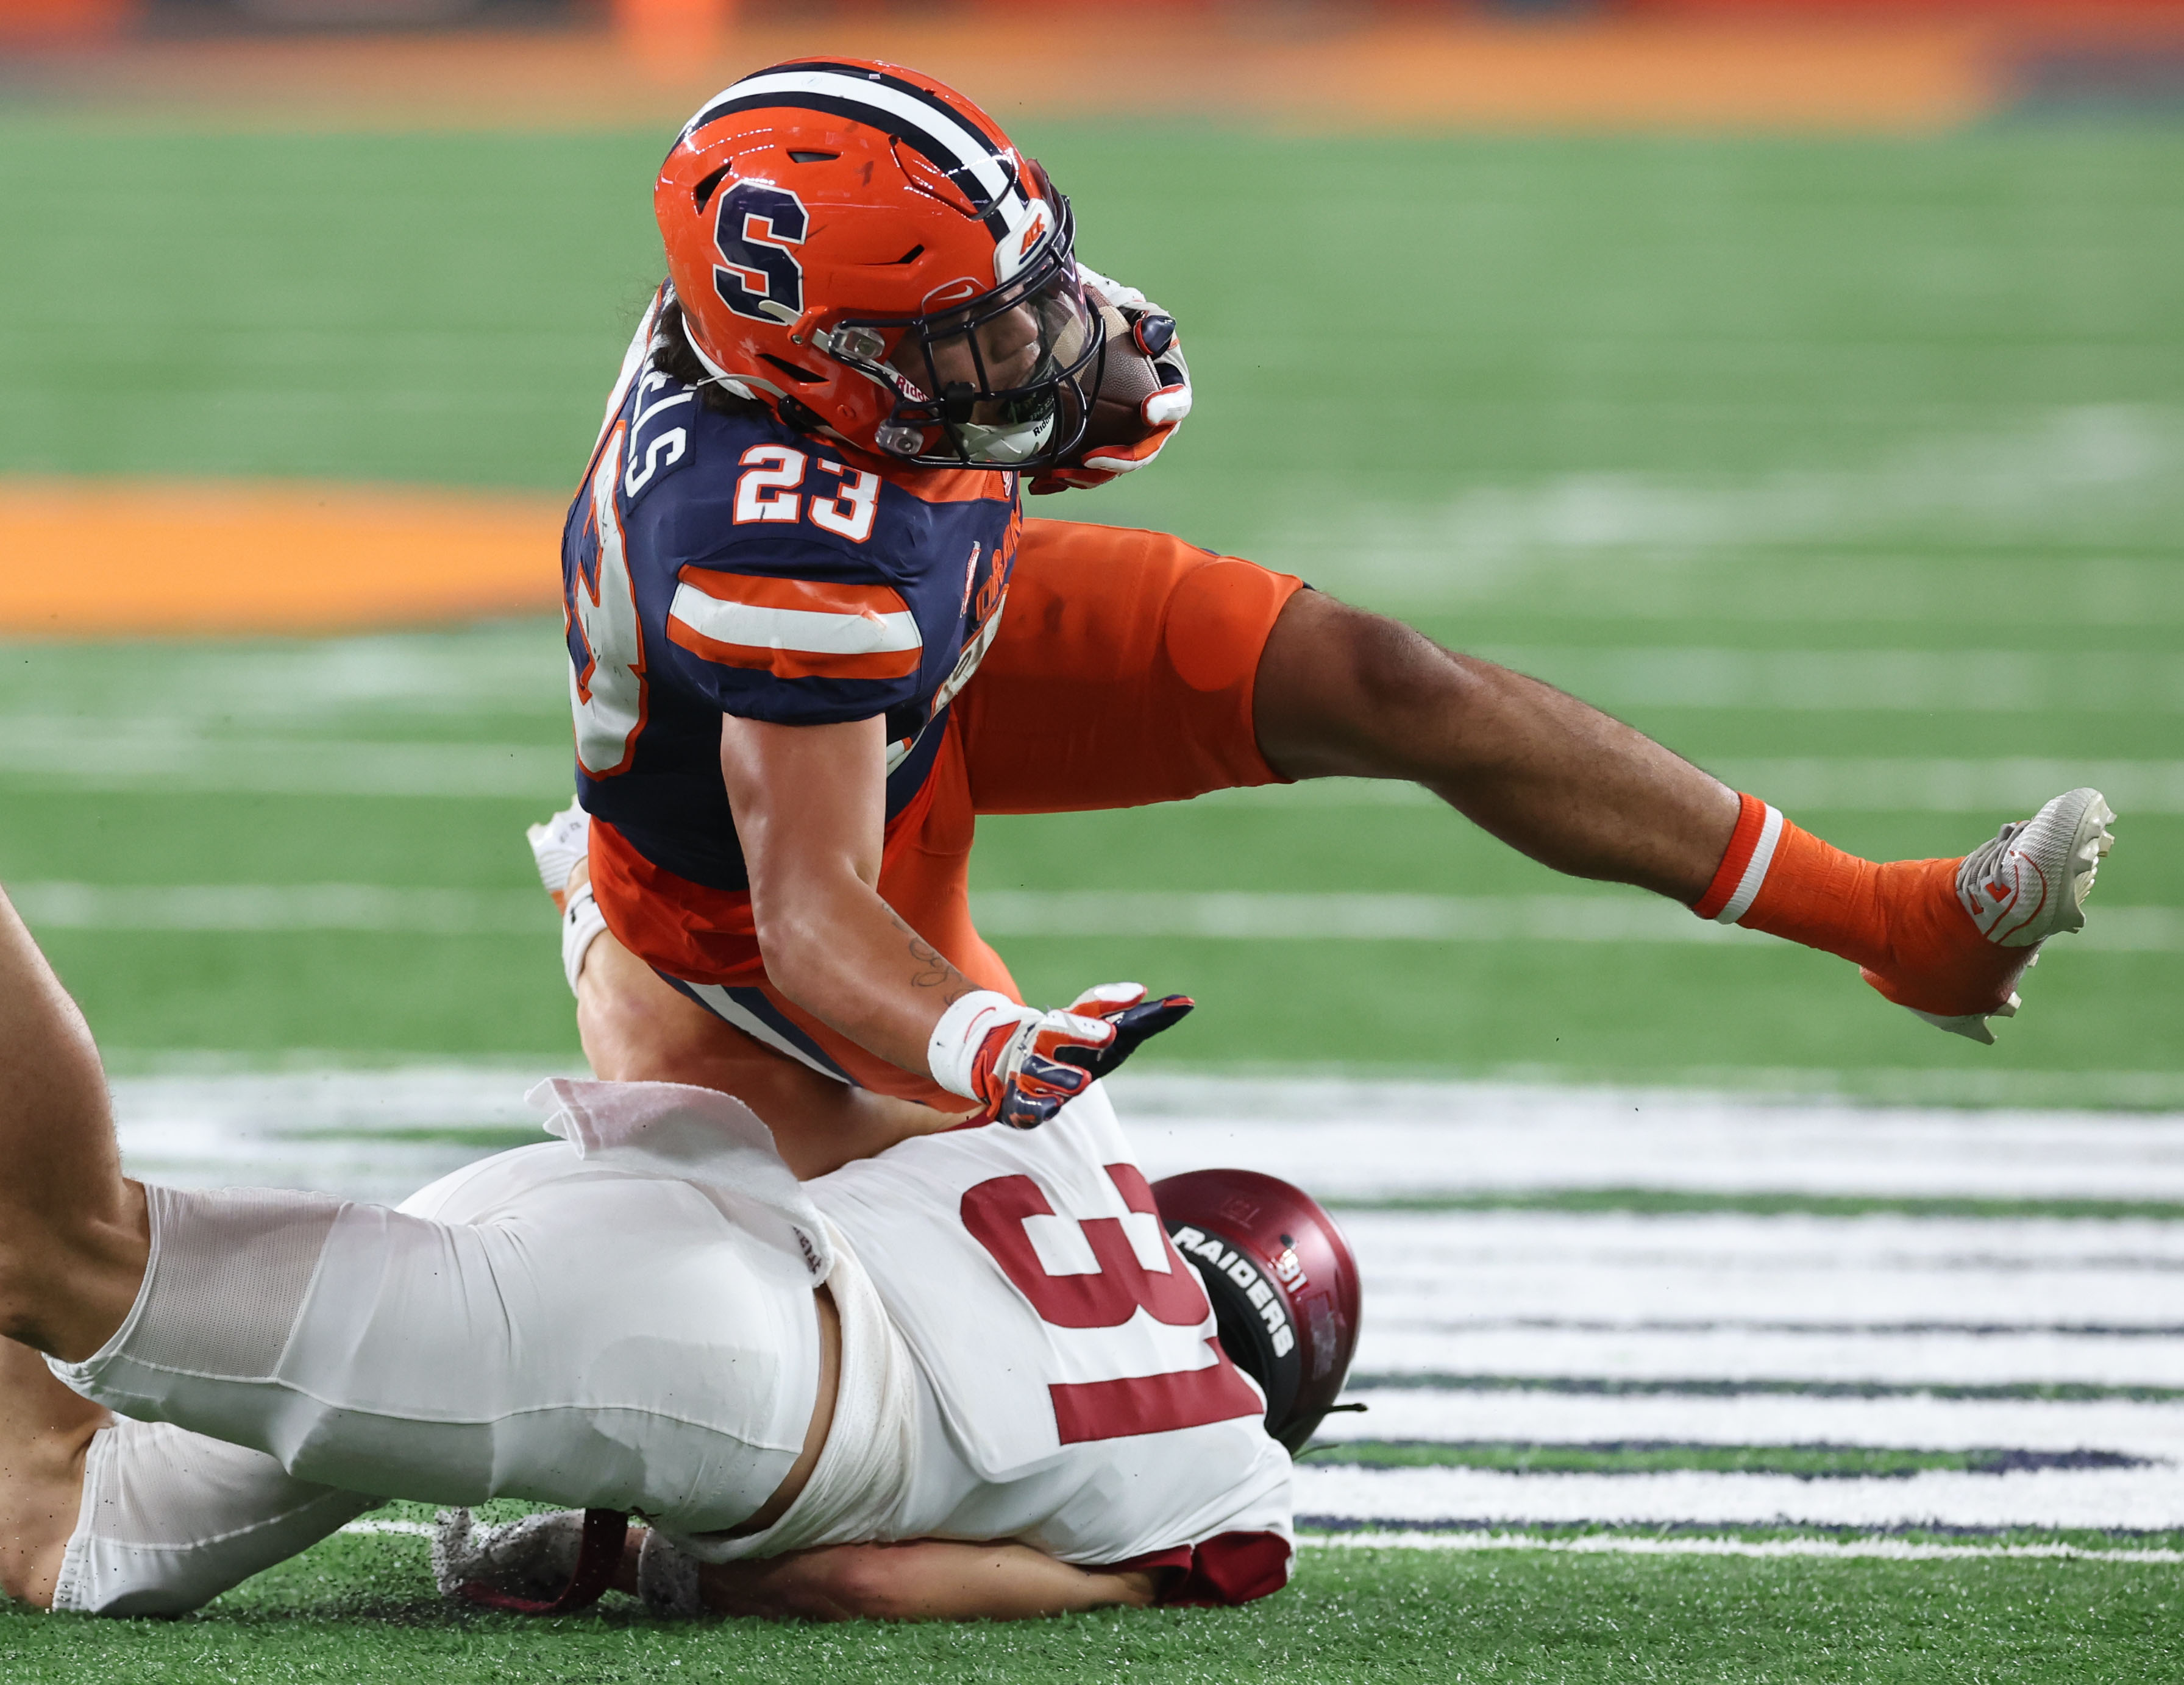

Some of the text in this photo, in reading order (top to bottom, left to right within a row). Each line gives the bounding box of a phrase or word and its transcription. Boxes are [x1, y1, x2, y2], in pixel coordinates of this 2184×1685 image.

[713, 178, 810, 327] S
[1020, 212, 1045, 256] ACC
[733, 442, 882, 544] 23
[960, 1162, 1265, 1446] 31
[1172, 1226, 1295, 1358] RAIDERS
